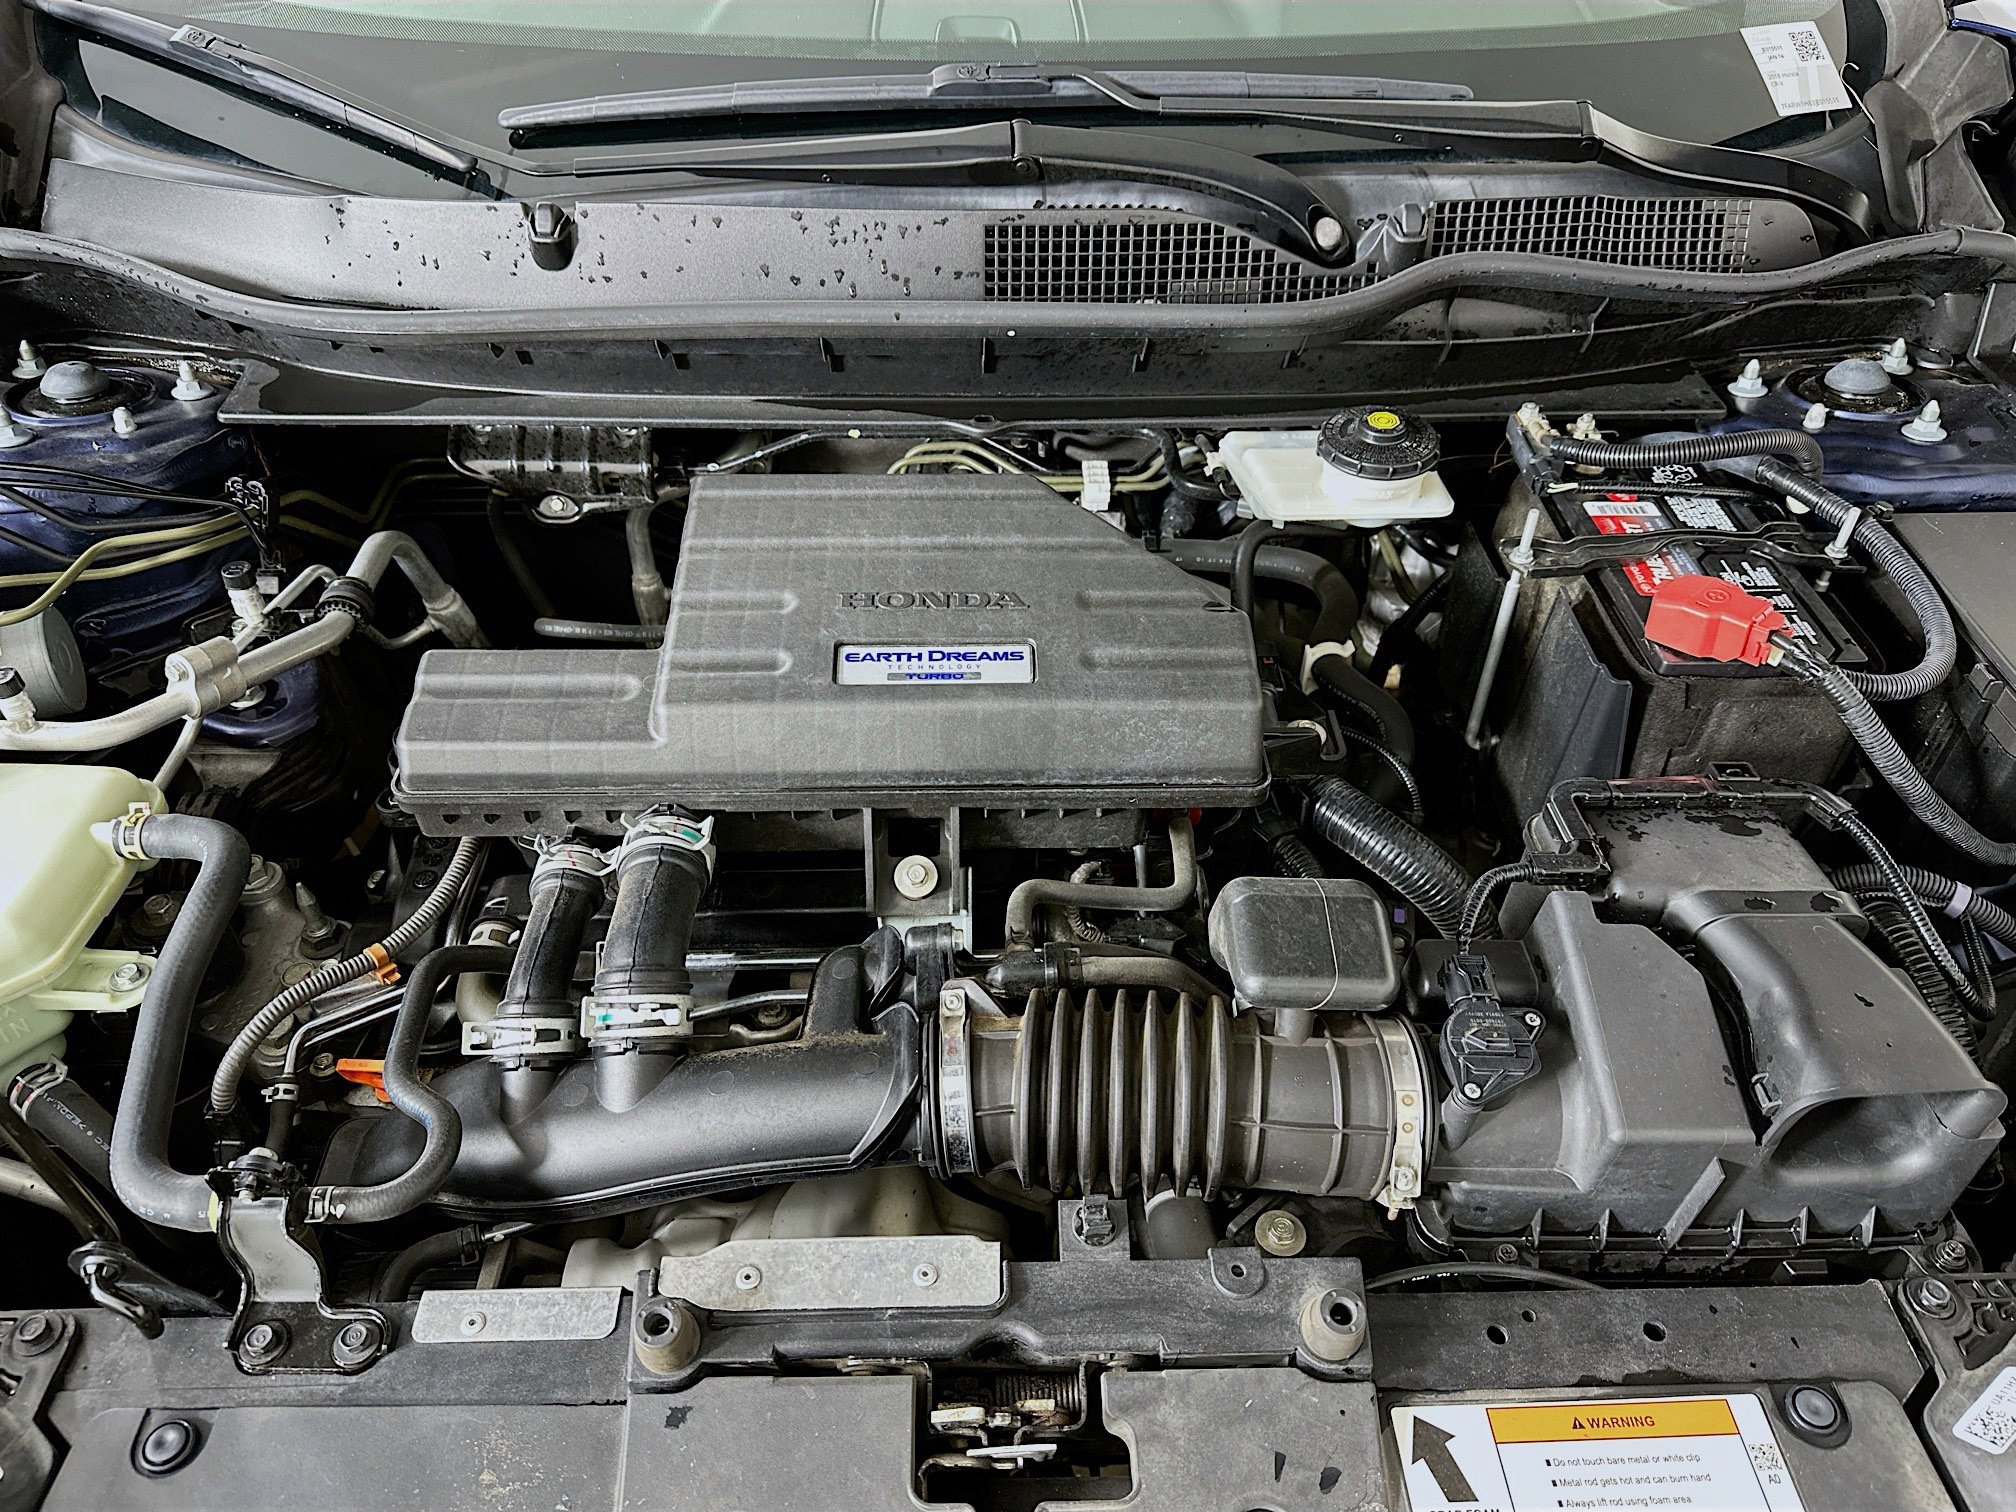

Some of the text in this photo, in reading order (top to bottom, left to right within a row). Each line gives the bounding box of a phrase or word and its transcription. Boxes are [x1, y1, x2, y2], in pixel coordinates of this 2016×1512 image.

[837, 592, 1030, 610] HONDA
[845, 650, 1025, 662] EARTH DREAMS
[1586, 1415, 1656, 1429] WARNING
[1553, 1453, 1701, 1467] Do not touch bare metal or white clip
[1559, 1473, 1712, 1488] Metal rod gets hot and can burn hand
[1566, 1496, 1692, 1509] Always lift rod using foam area
